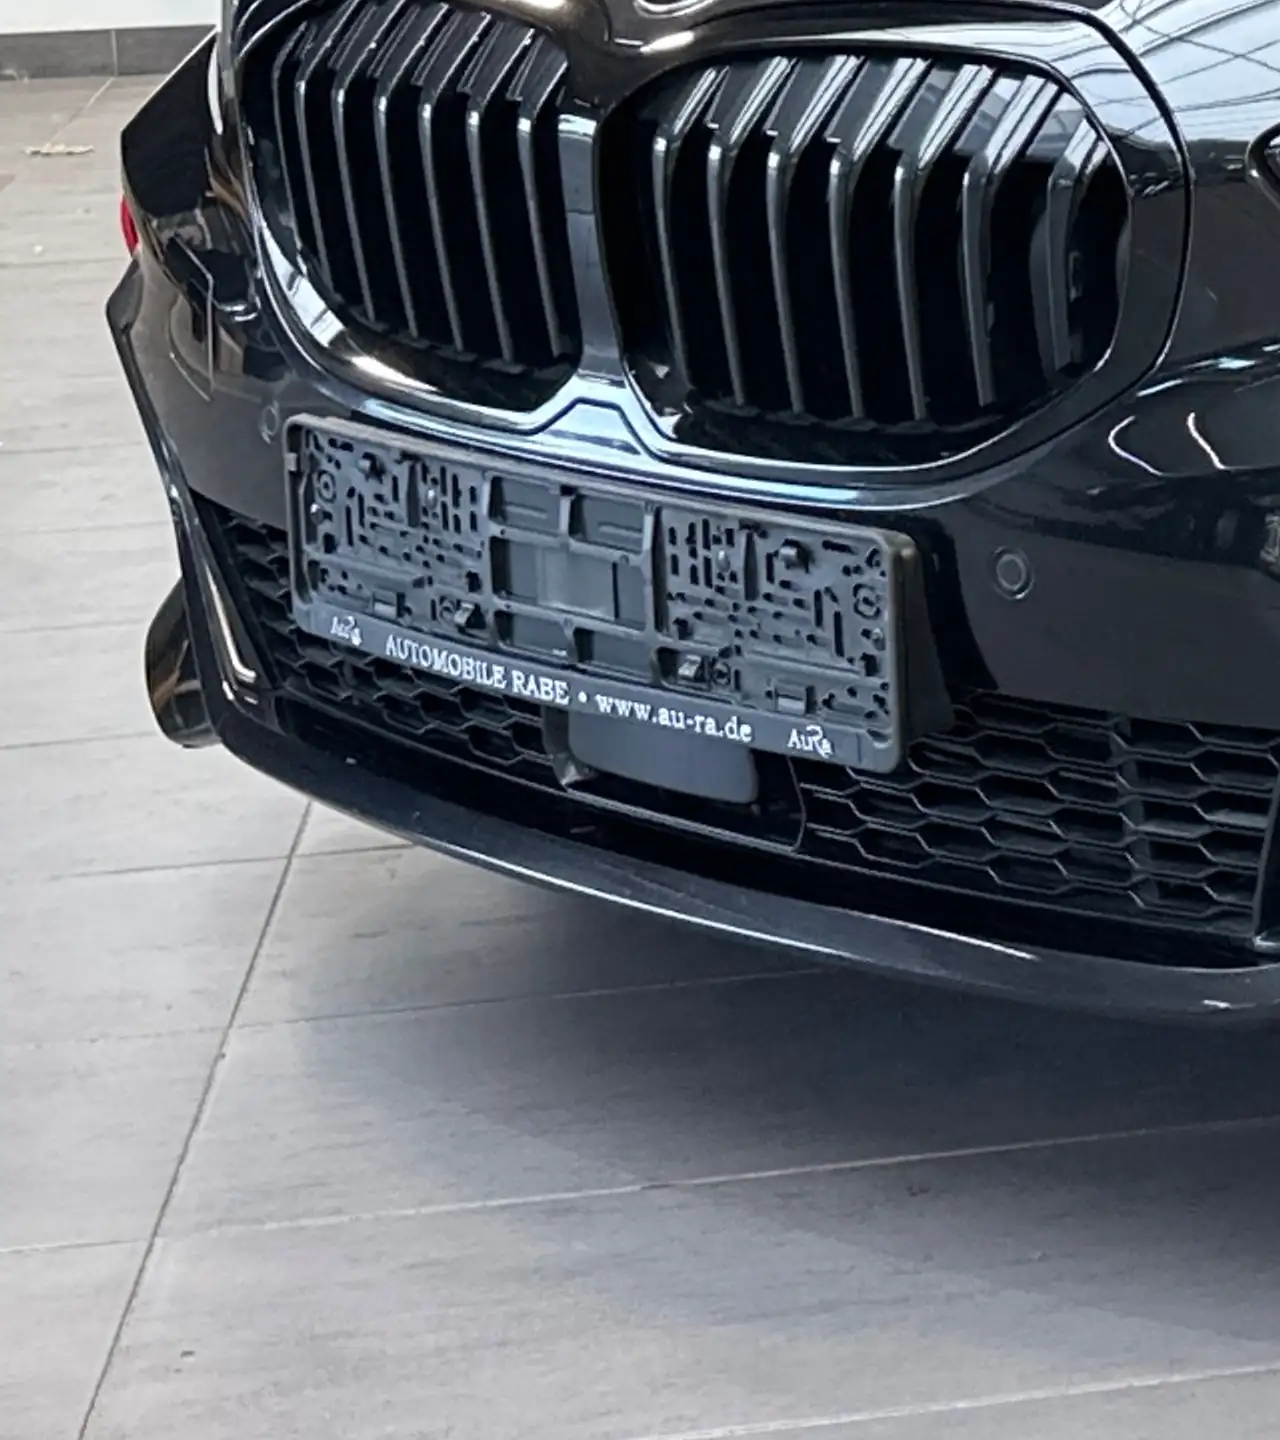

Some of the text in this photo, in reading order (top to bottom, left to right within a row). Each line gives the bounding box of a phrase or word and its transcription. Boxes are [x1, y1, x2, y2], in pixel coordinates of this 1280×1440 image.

[384, 633, 508, 690] AUTOMOBILE
[511, 669, 570, 706] RABE
[594, 693, 753, 743] www.au-ra.de
[786, 724, 835, 760] AuRa
